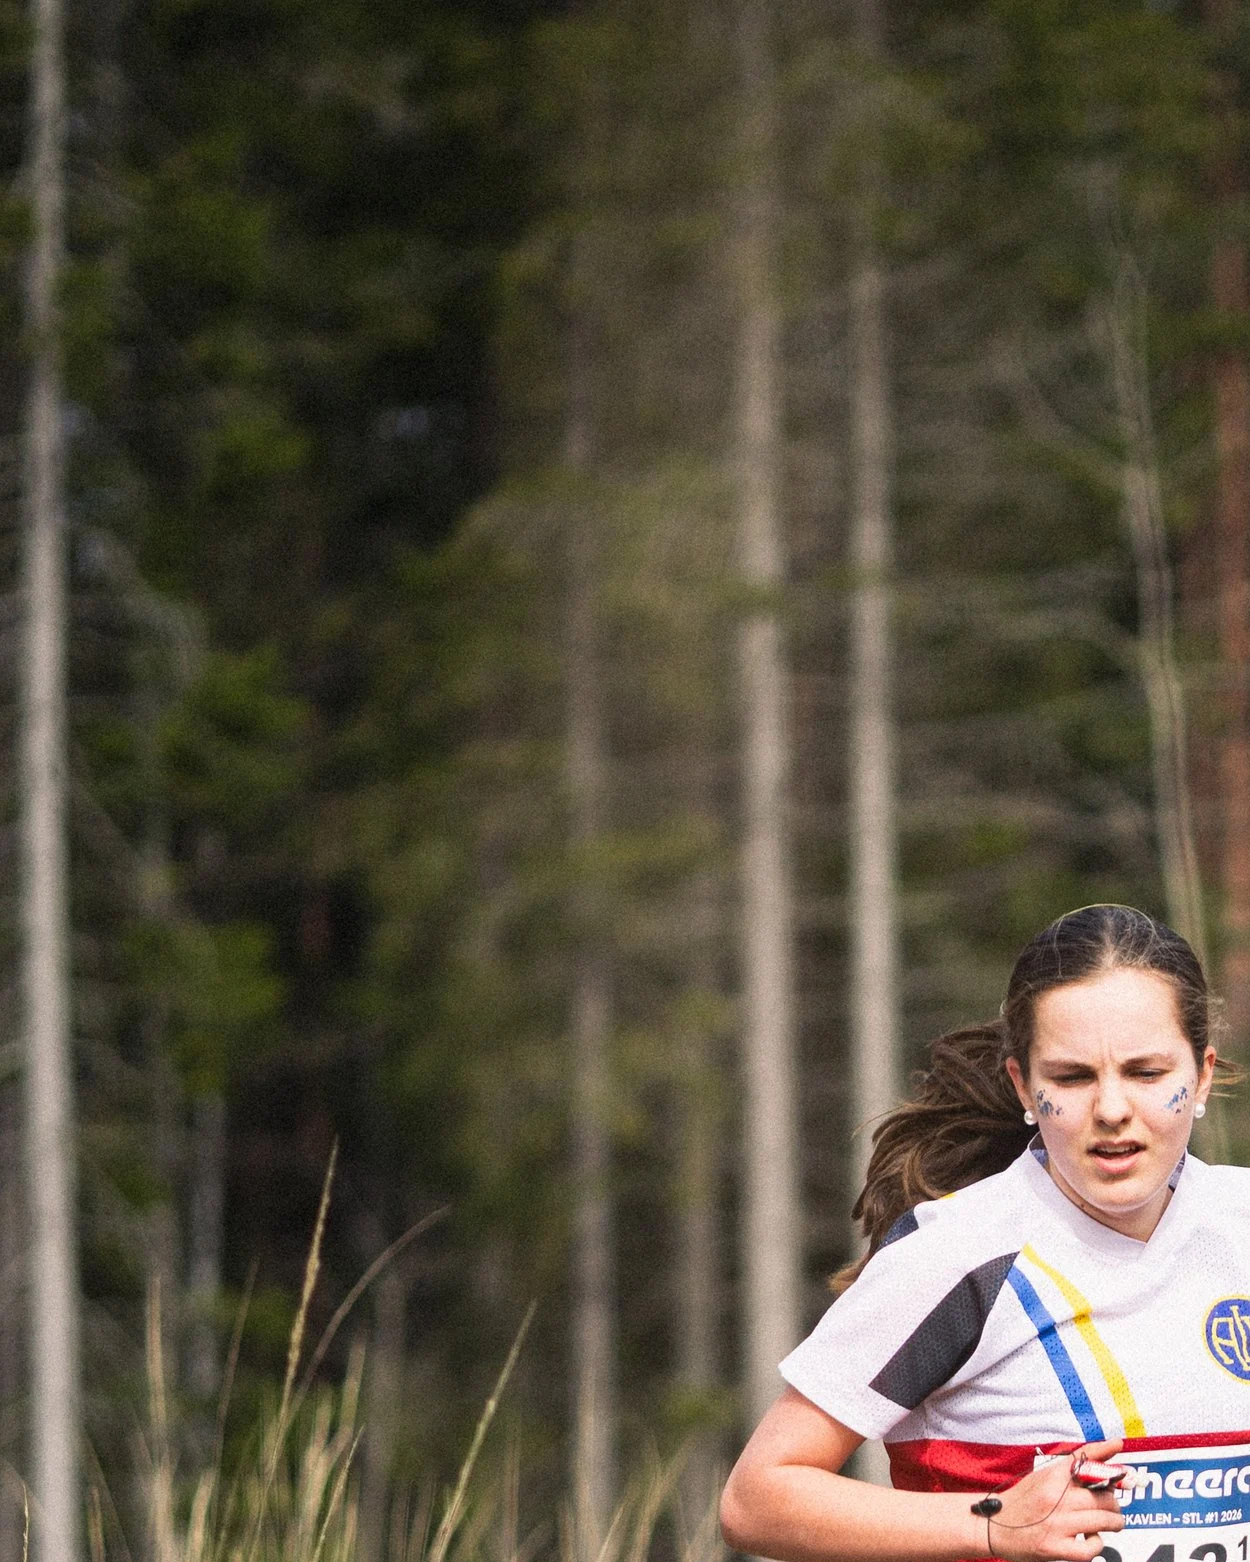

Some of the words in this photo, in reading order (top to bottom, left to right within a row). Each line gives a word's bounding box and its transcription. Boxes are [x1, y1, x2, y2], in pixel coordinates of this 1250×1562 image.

[1182, 1511, 1204, 1524] STL
[1205, 1511, 1219, 1523] #1
[1221, 1508, 1243, 1522] 2026
